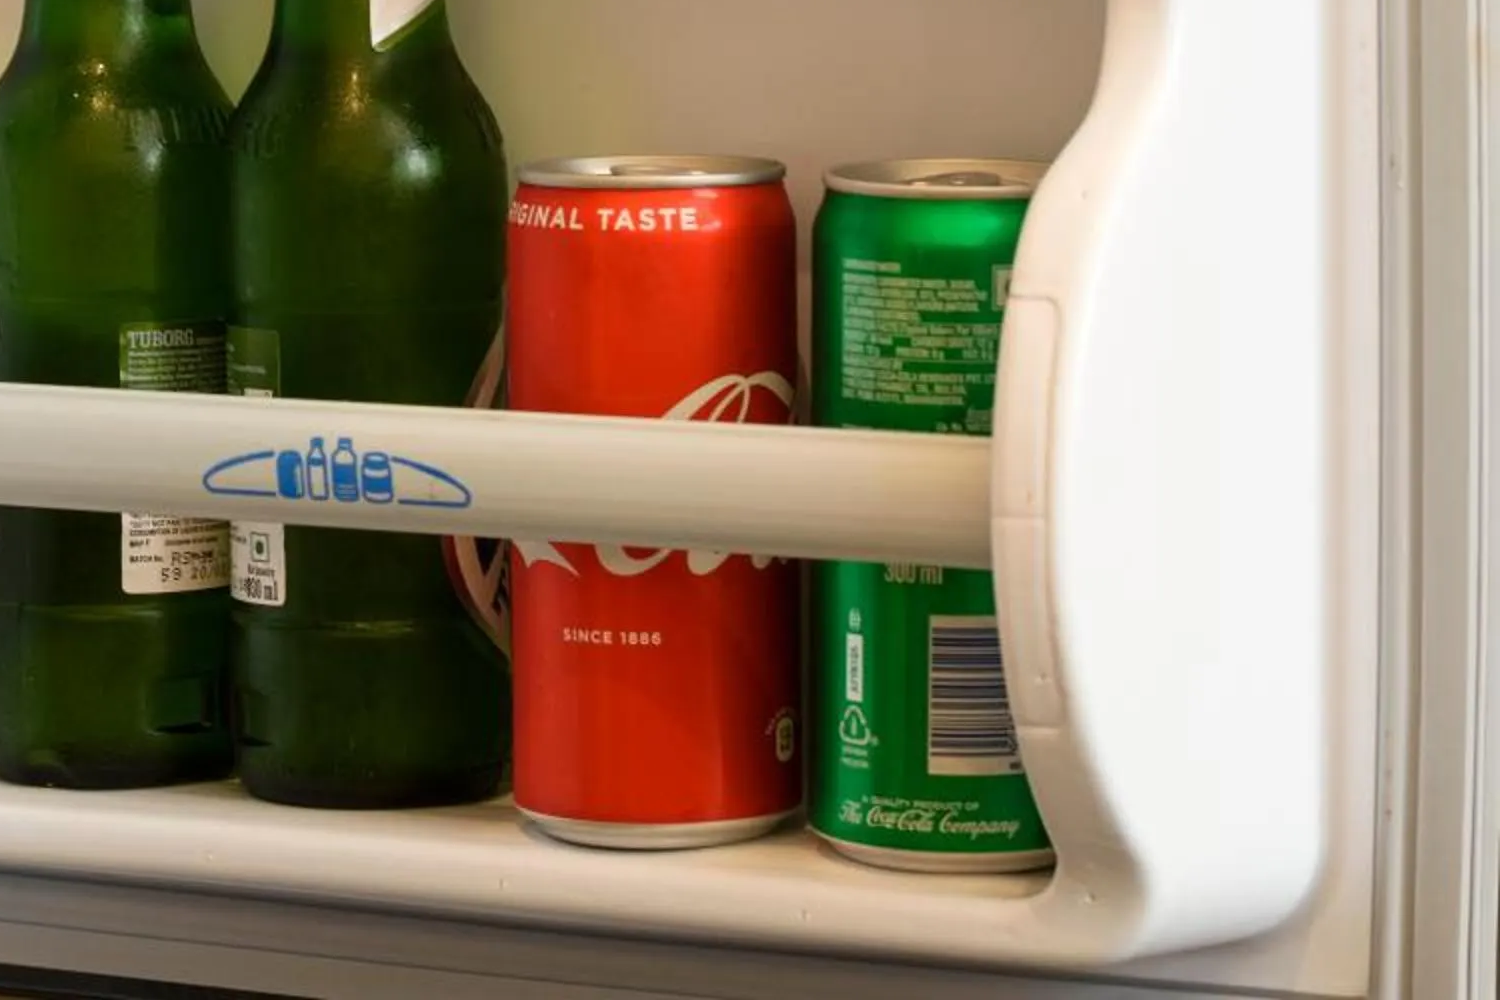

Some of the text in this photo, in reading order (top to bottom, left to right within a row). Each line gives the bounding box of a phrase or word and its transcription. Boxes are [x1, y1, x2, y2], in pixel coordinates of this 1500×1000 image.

[597, 207, 698, 231] TASTE
[128, 328, 194, 349] TUBORG
[562, 628, 613, 645] SINCE
[938, 809, 1020, 840] Company
